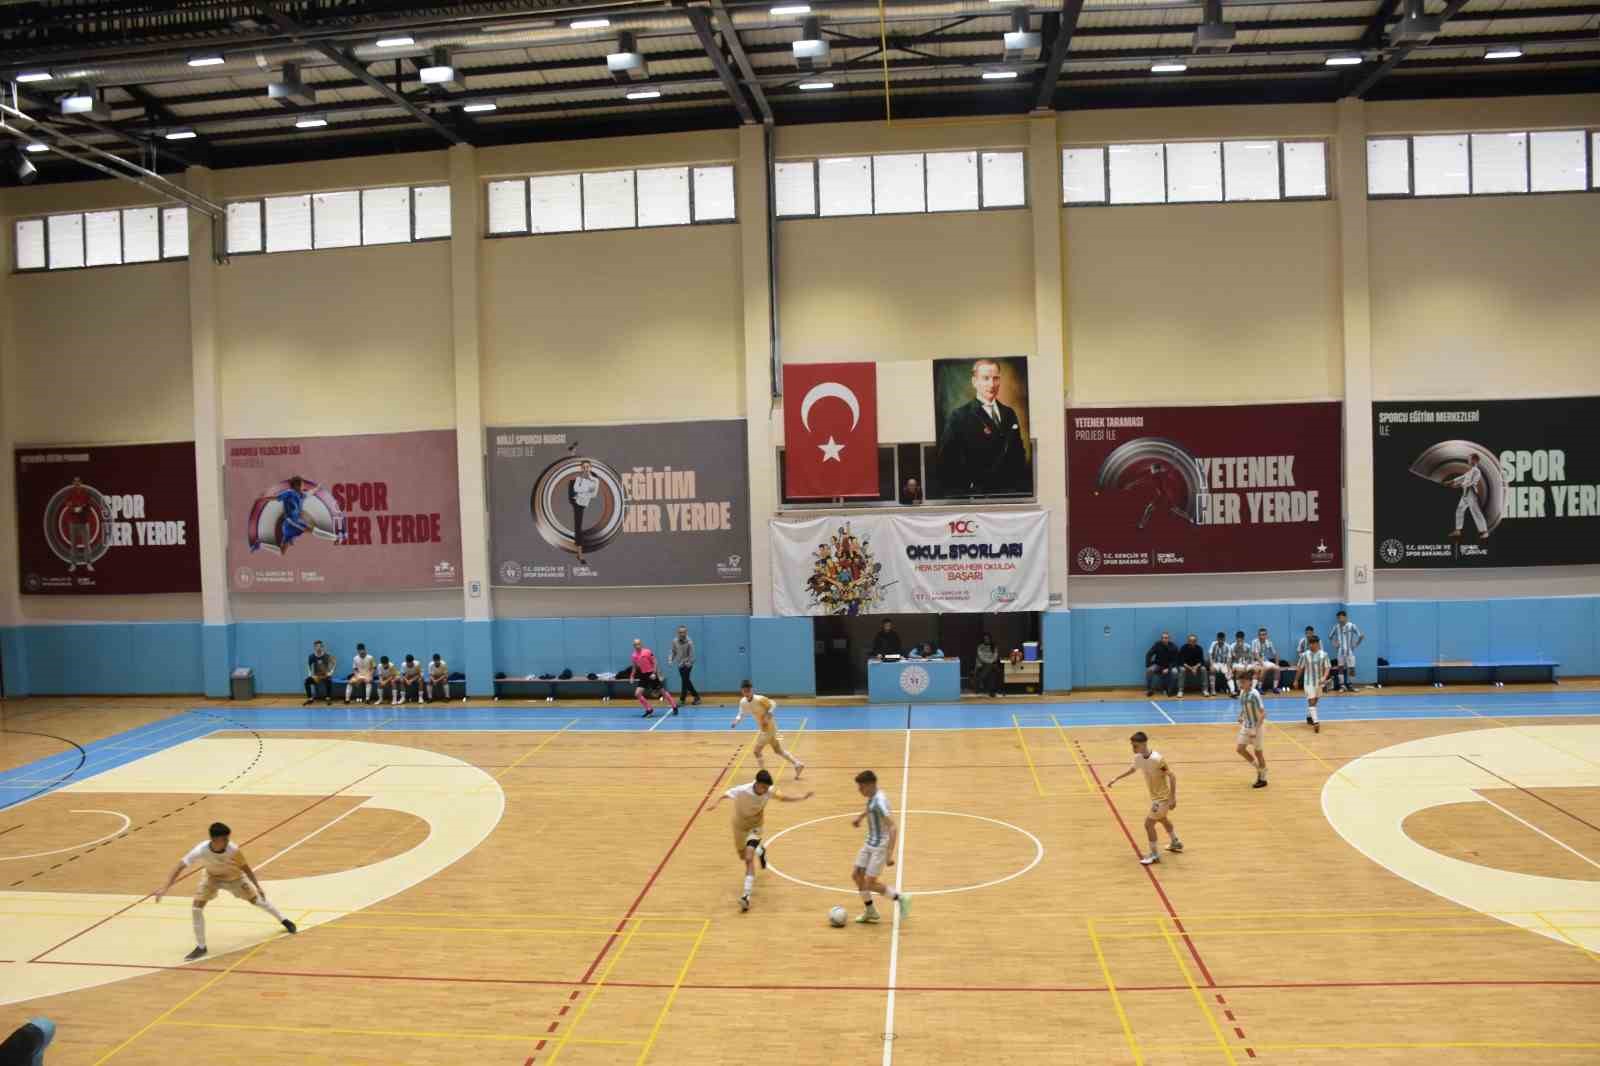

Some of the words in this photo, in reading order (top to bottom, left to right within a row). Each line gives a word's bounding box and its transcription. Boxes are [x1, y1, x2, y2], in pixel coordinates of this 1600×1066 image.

[1074, 417, 1105, 428] YETENEK
[1195, 455, 1296, 489] YETENEK
[1500, 449, 1566, 482] SPOR
[332, 482, 388, 512] SPOR
[621, 465, 697, 500] EĞİTİM
[102, 494, 145, 519] SPOR
[623, 504, 662, 533] HER
[666, 501, 731, 531] YERDE
[1196, 492, 1241, 525] HER
[1246, 490, 1319, 523] YERDE
[1503, 486, 1546, 519] HER
[135, 520, 186, 546] YERDE
[376, 513, 441, 545] YERDE
[906, 544, 948, 560] OKUL
[949, 543, 1023, 559] SPORLARI
